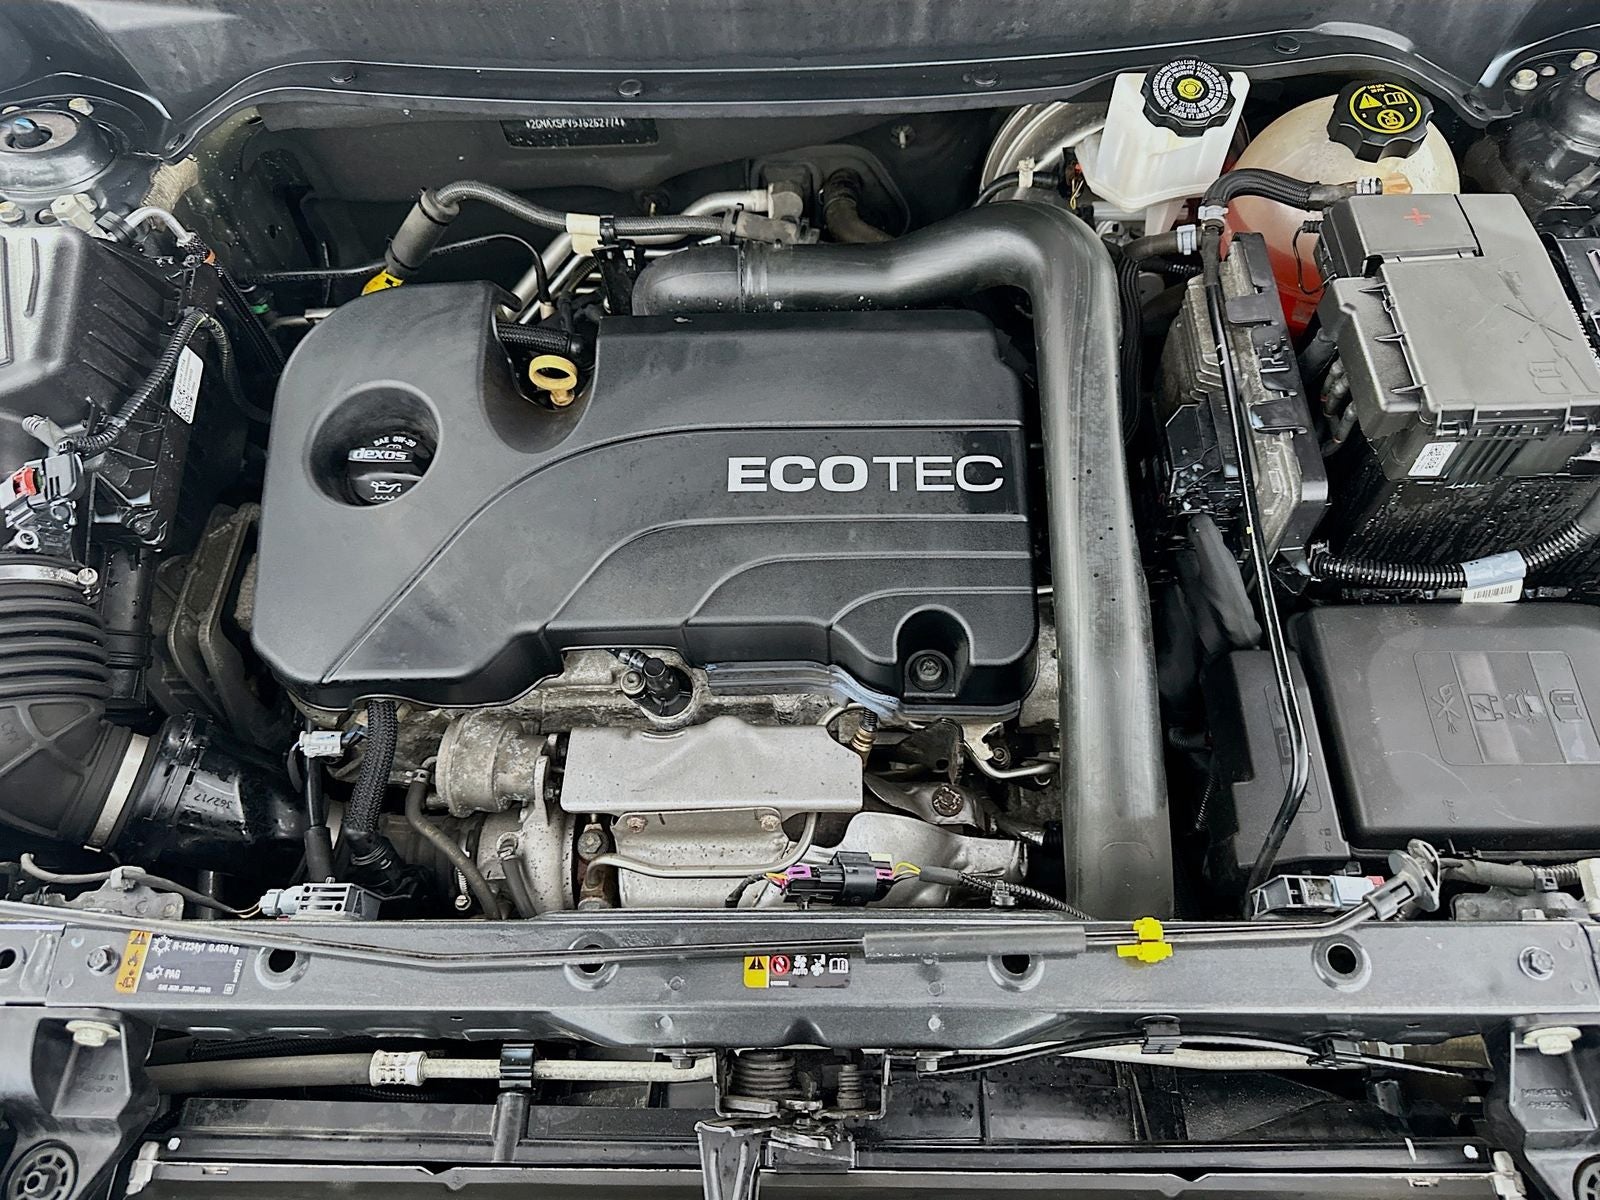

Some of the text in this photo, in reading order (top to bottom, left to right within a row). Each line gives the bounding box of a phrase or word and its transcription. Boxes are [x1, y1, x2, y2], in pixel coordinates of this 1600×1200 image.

[373, 436, 389, 447] SAE
[352, 447, 409, 461] dexos
[727, 455, 1004, 493] ECOTEC
[164, 968, 181, 979] PAG
